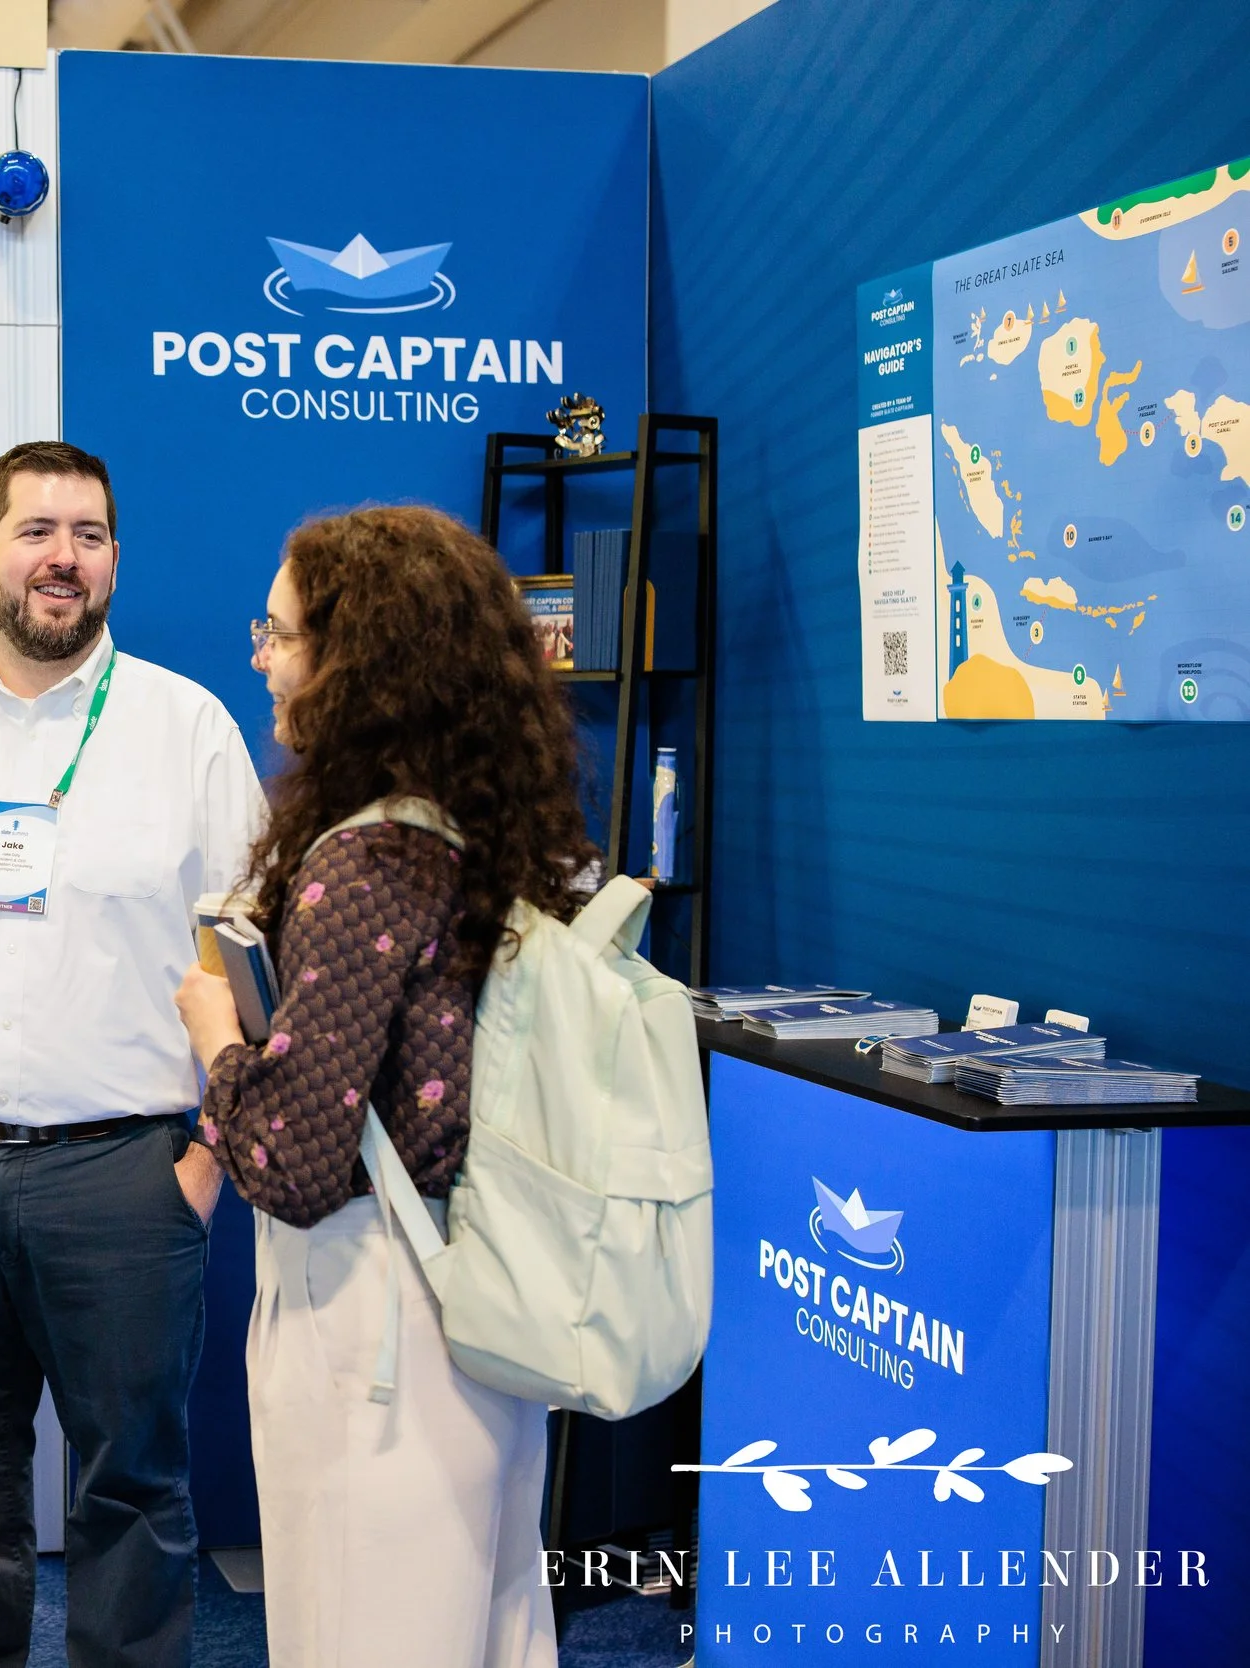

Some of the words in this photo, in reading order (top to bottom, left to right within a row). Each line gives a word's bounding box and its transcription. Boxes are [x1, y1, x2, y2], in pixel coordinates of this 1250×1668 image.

[1114, 215, 1120, 226] 11
[1228, 236, 1233, 247] 5
[1222, 259, 1239, 268] SMOOTH
[955, 277, 971, 294] THE
[974, 265, 1008, 288] GREAT
[1011, 256, 1042, 278] SLATE
[1045, 249, 1065, 267] SEA
[871, 308, 887, 322] POST
[887, 301, 915, 317] CAPTAIN
[880, 314, 906, 327] CONSULTING
[1008, 318, 1012, 327] 7
[864, 338, 922, 365] NAVIGATOR'S
[1070, 341, 1074, 351] 1
[153, 331, 301, 378] POST
[314, 334, 564, 384] CAPTAIN
[878, 358, 905, 376] GUIDE
[1074, 391, 1083, 404] 12
[240, 388, 480, 423] CONSULTING
[1138, 404, 1158, 412] CAPTAIN'S
[1220, 419, 1240, 427] CAPTAIN
[1145, 429, 1150, 439] 6
[1191, 440, 1196, 450] 9
[973, 451, 978, 460] 2
[1230, 513, 1241, 524] 14
[1066, 532, 1074, 541] 10
[975, 598, 979, 607] 4
[1035, 629, 1039, 637] 3
[1077, 671, 1082, 681] 8
[100, 678, 109, 692] slate
[1184, 686, 1194, 697] 13
[89, 715, 98, 731] slate
[2, 841, 25, 850] Jake
[759, 1239, 826, 1305] POST
[830, 1275, 965, 1375] CAPTAIN
[796, 1307, 914, 1390] CONSULTING
